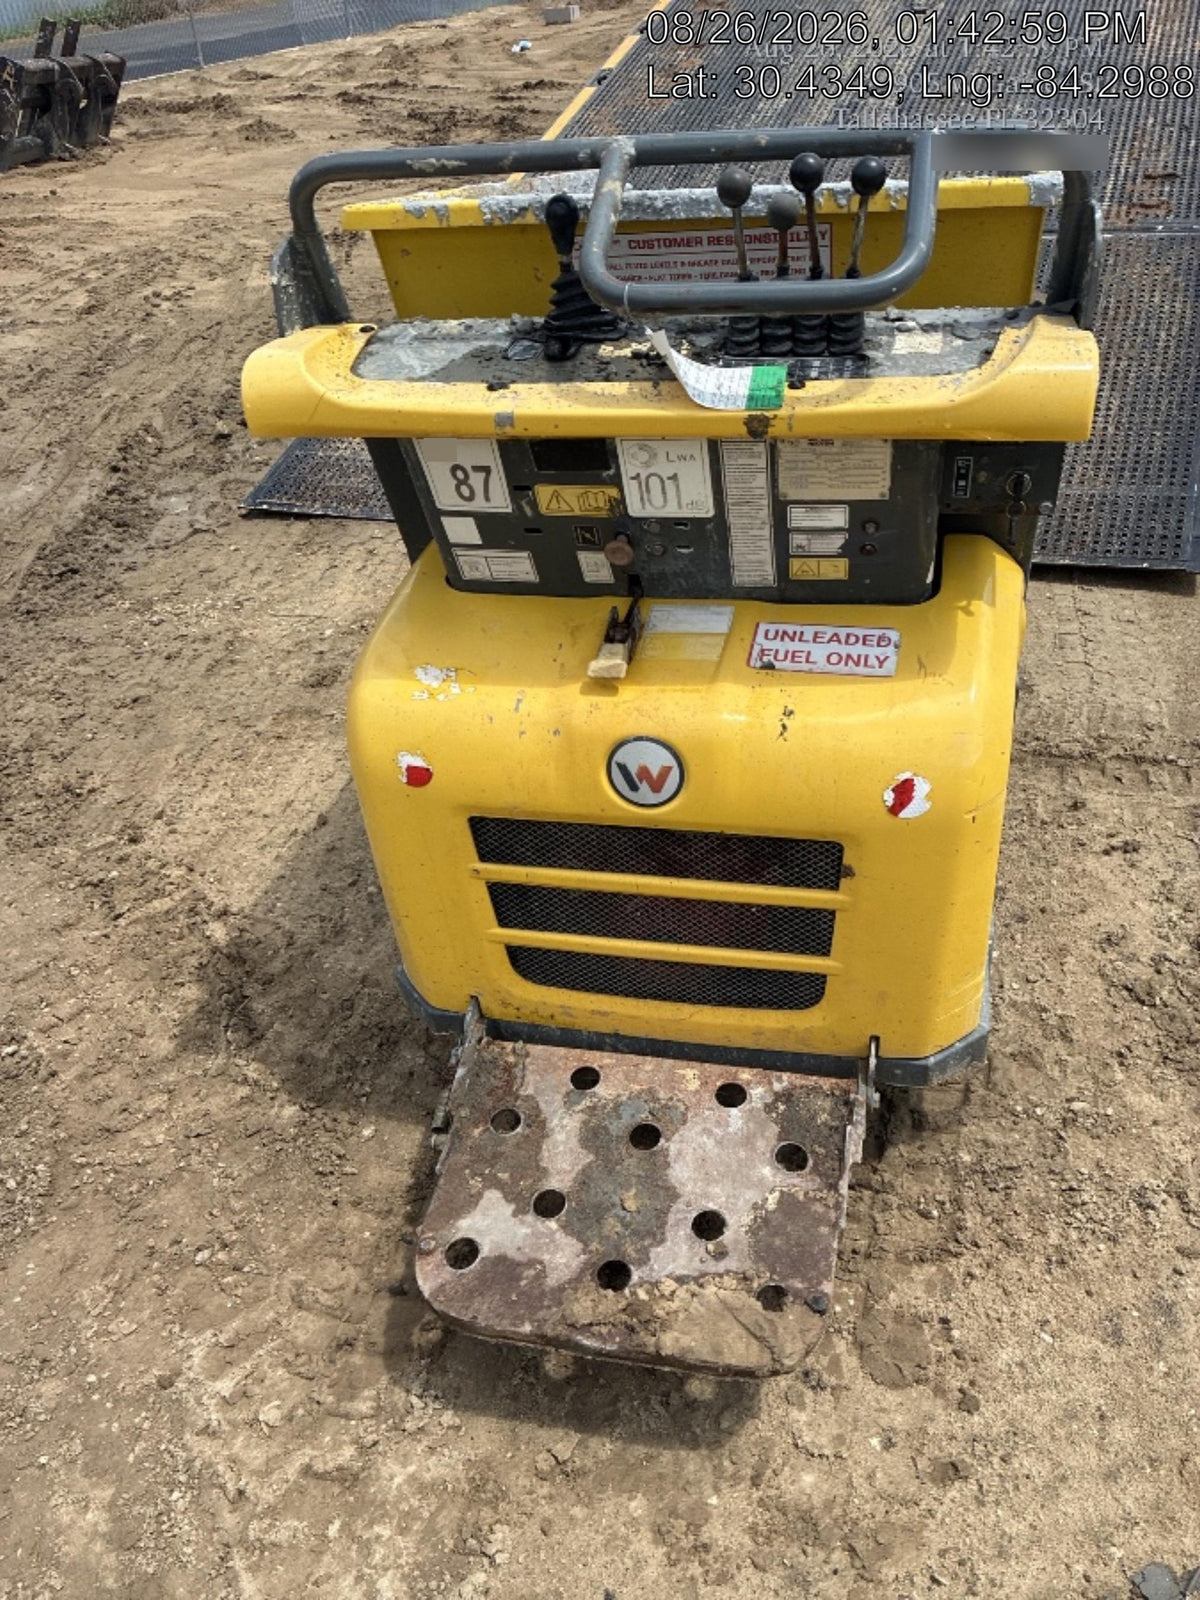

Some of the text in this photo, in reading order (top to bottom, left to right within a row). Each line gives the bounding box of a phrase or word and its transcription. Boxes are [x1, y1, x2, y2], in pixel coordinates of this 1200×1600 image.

[627, 236, 703, 250] CUSTOMER
[450, 463, 491, 503] 87
[629, 472, 683, 510] 101
[763, 628, 893, 648] UNLEADED
[760, 648, 890, 669] FUEL ONLY
